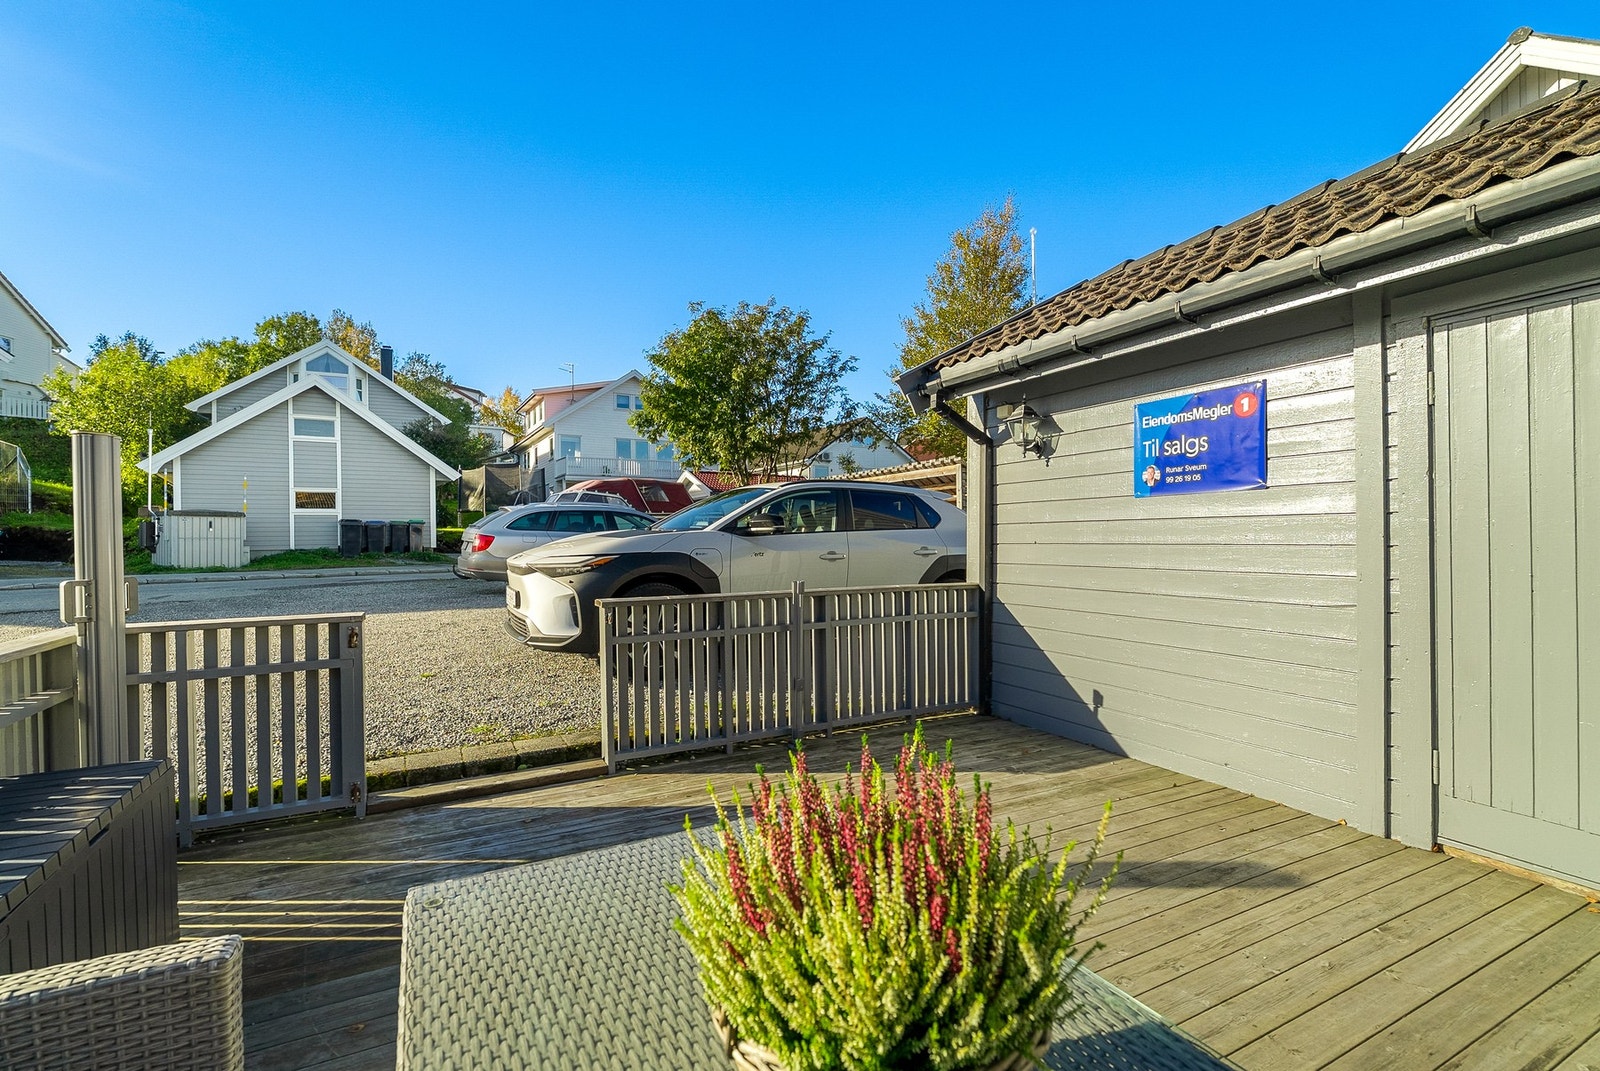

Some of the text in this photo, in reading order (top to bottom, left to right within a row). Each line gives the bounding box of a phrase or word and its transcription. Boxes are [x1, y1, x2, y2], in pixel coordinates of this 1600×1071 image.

[1142, 397, 1249, 429] EiendomsMegler 1
[1143, 434, 1209, 458] Til salgs
[1165, 464, 1207, 474] Runar Sveum
[1165, 476, 1174, 484] 99
[1174, 475, 1184, 483] 26
